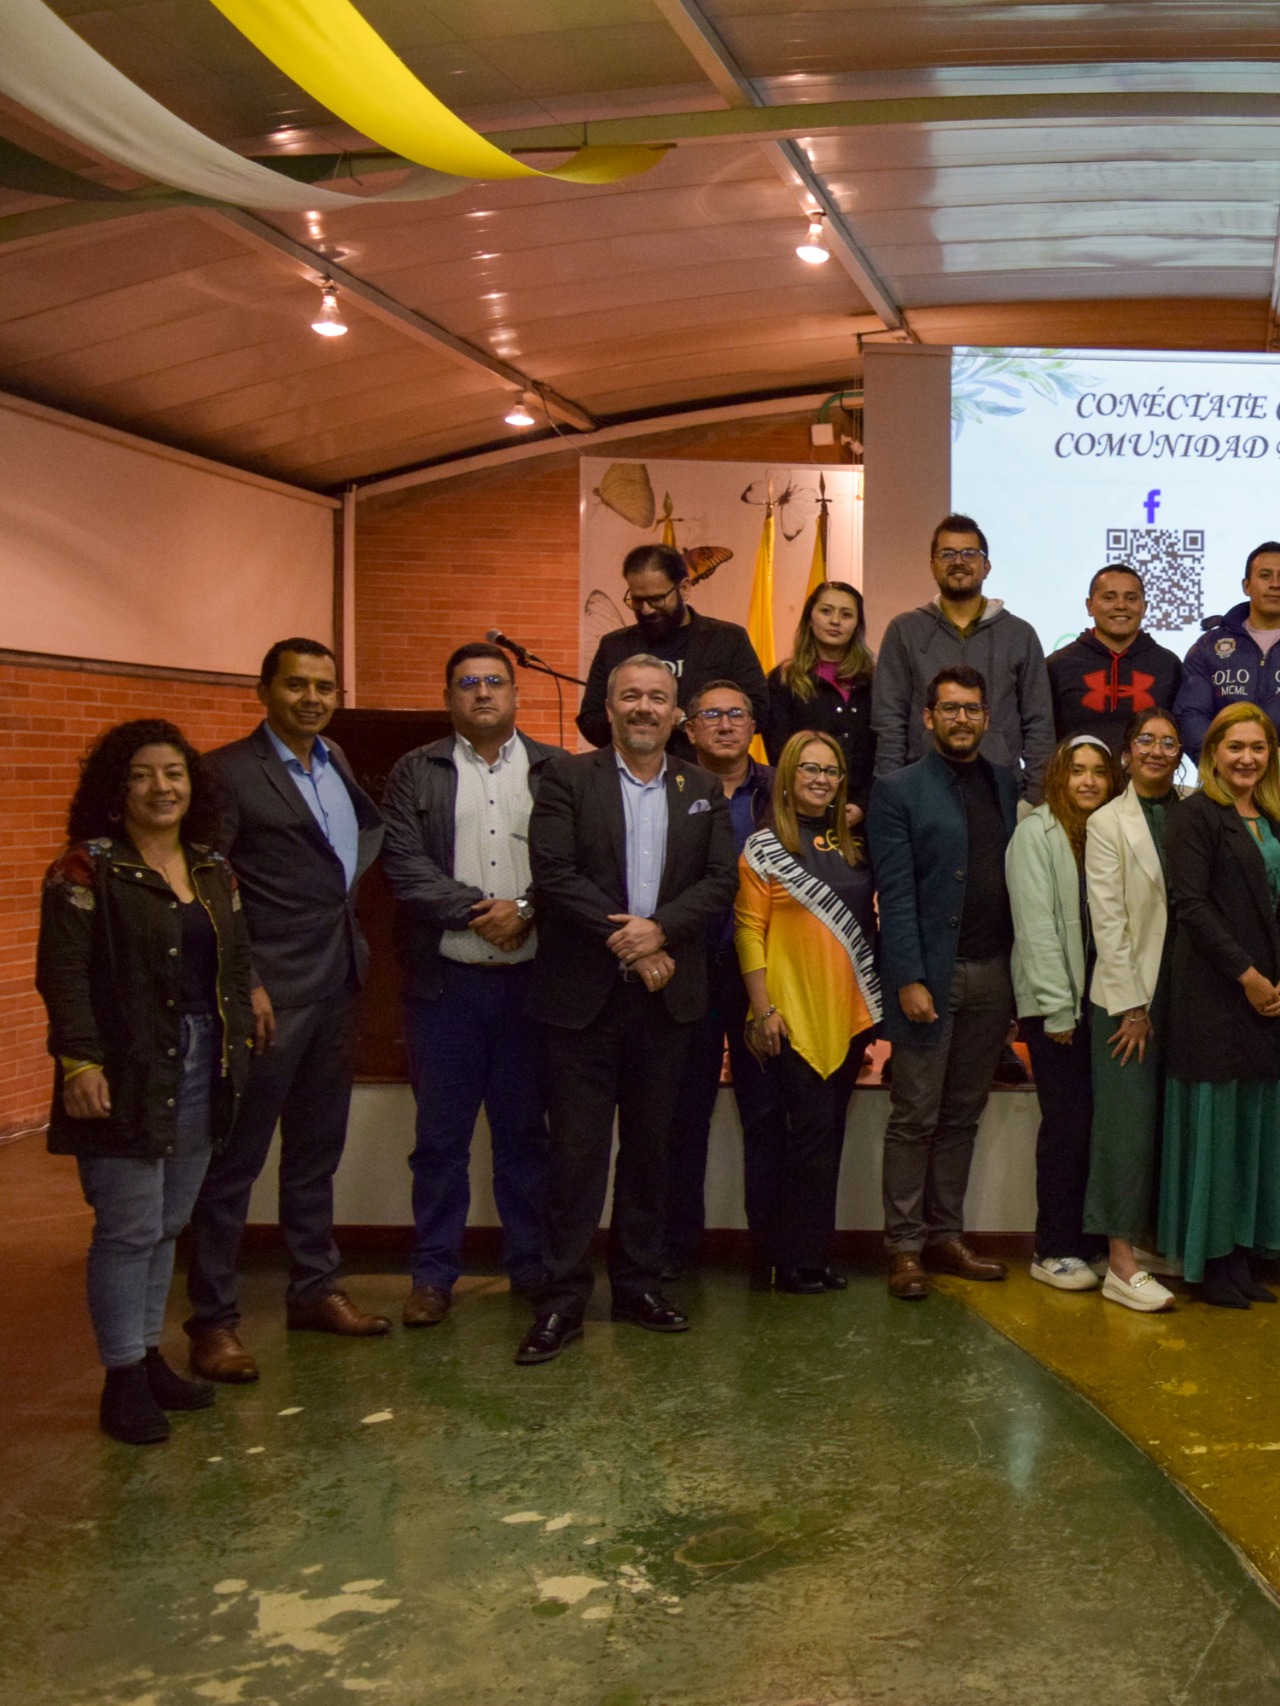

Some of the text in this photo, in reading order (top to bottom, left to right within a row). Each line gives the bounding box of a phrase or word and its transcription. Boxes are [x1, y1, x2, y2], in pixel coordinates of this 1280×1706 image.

[1076, 386, 1267, 421] CONÉCTATE
[1054, 430, 1269, 461] COMUNIDAD
[1221, 684, 1249, 696] MCML
